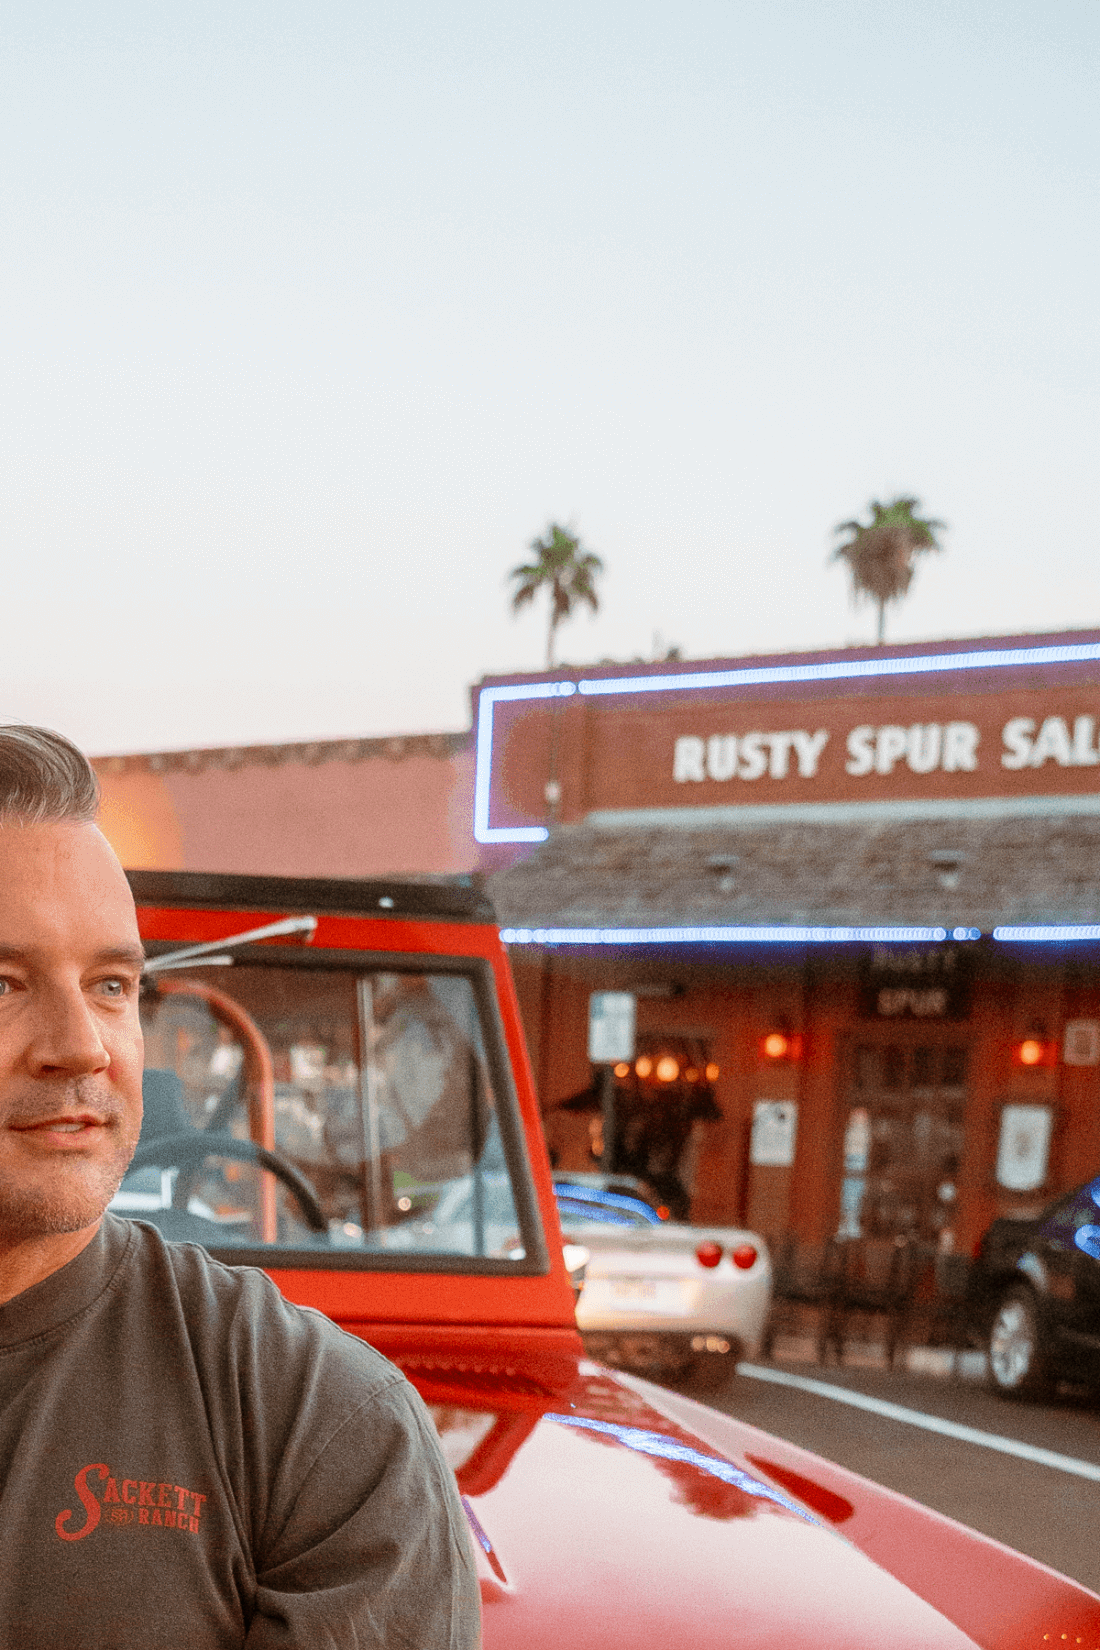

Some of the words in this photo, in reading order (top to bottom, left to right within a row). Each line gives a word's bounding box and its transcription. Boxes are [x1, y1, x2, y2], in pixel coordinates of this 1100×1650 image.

[673, 729, 829, 783] RUSTY
[845, 720, 980, 776] SPUR
[1001, 714, 1100, 770] SAL
[55, 1463, 207, 1541] SACKETT
[138, 1508, 200, 1535] RANCH
